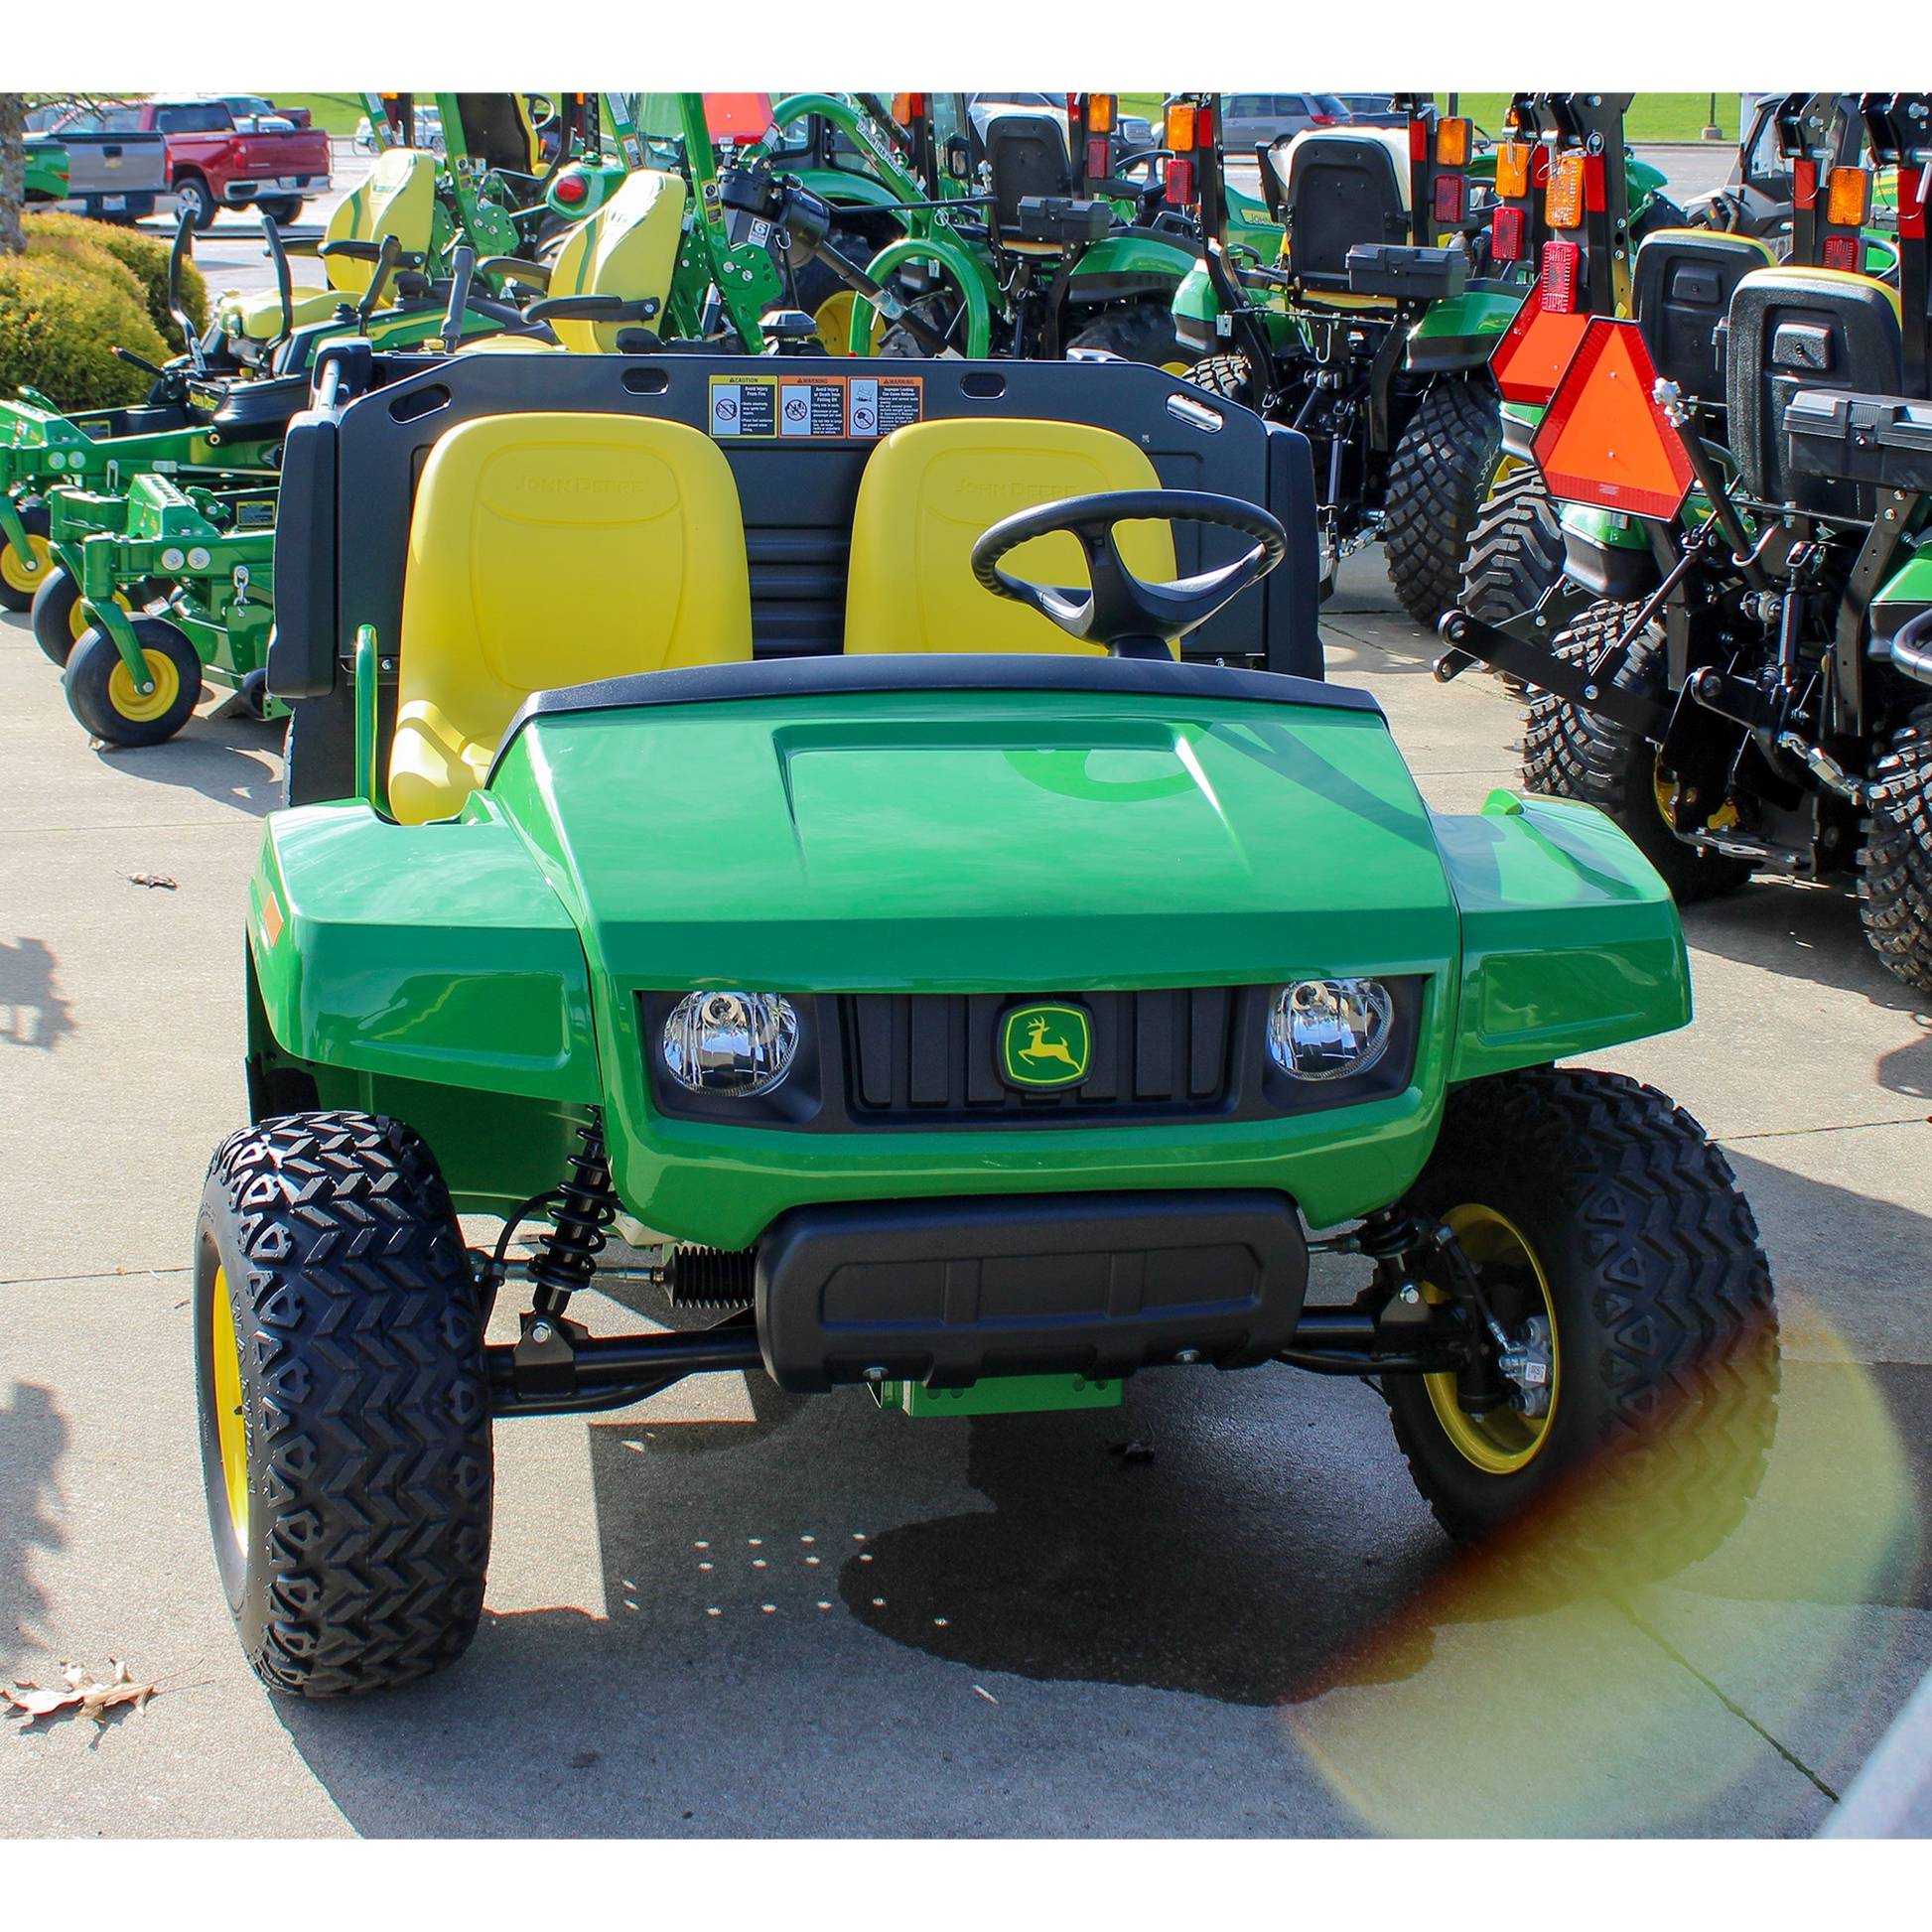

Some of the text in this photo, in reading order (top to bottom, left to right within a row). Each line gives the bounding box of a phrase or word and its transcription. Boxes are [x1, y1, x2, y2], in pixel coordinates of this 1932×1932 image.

[754, 223, 766, 234] 6
[516, 475, 644, 495] JOHN DEERE
[955, 480, 1076, 498] JOHN DEERE
